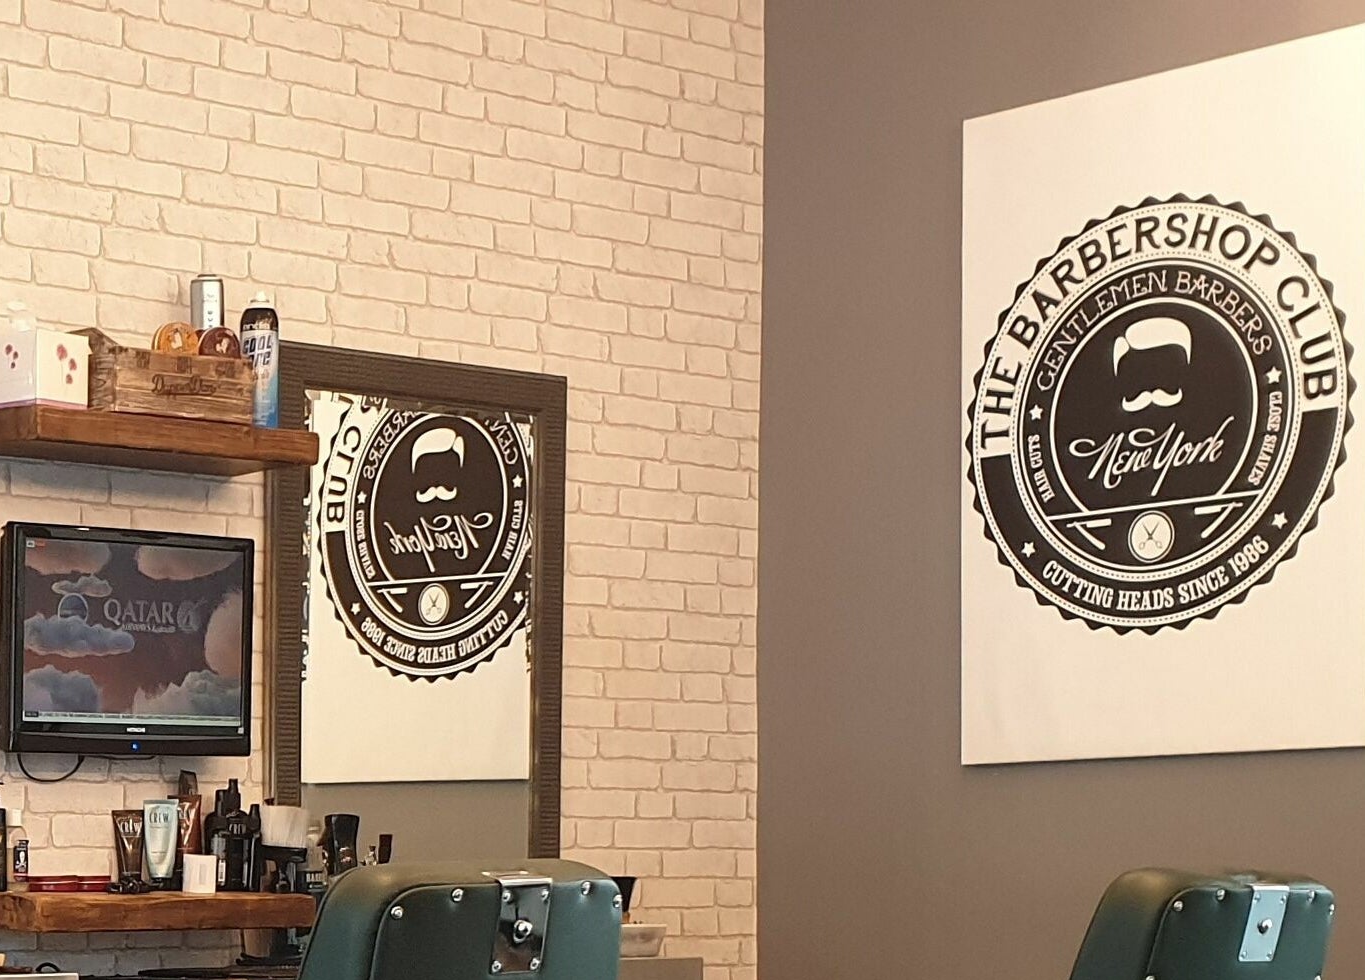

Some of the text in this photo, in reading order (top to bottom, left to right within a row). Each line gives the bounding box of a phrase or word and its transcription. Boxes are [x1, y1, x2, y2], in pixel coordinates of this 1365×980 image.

[980, 213, 1338, 450] THE BARBERSHOP CLUB
[1036, 269, 1273, 392] GENTLEMEN BARBERS
[1027, 434, 1055, 503] HAIR CUTS
[1069, 416, 1234, 497] New York
[1248, 391, 1282, 486] CLOSE SHAVES
[103, 598, 176, 626] QATAR
[1042, 535, 1270, 611] CUTTING HEADS SINCE 1986
